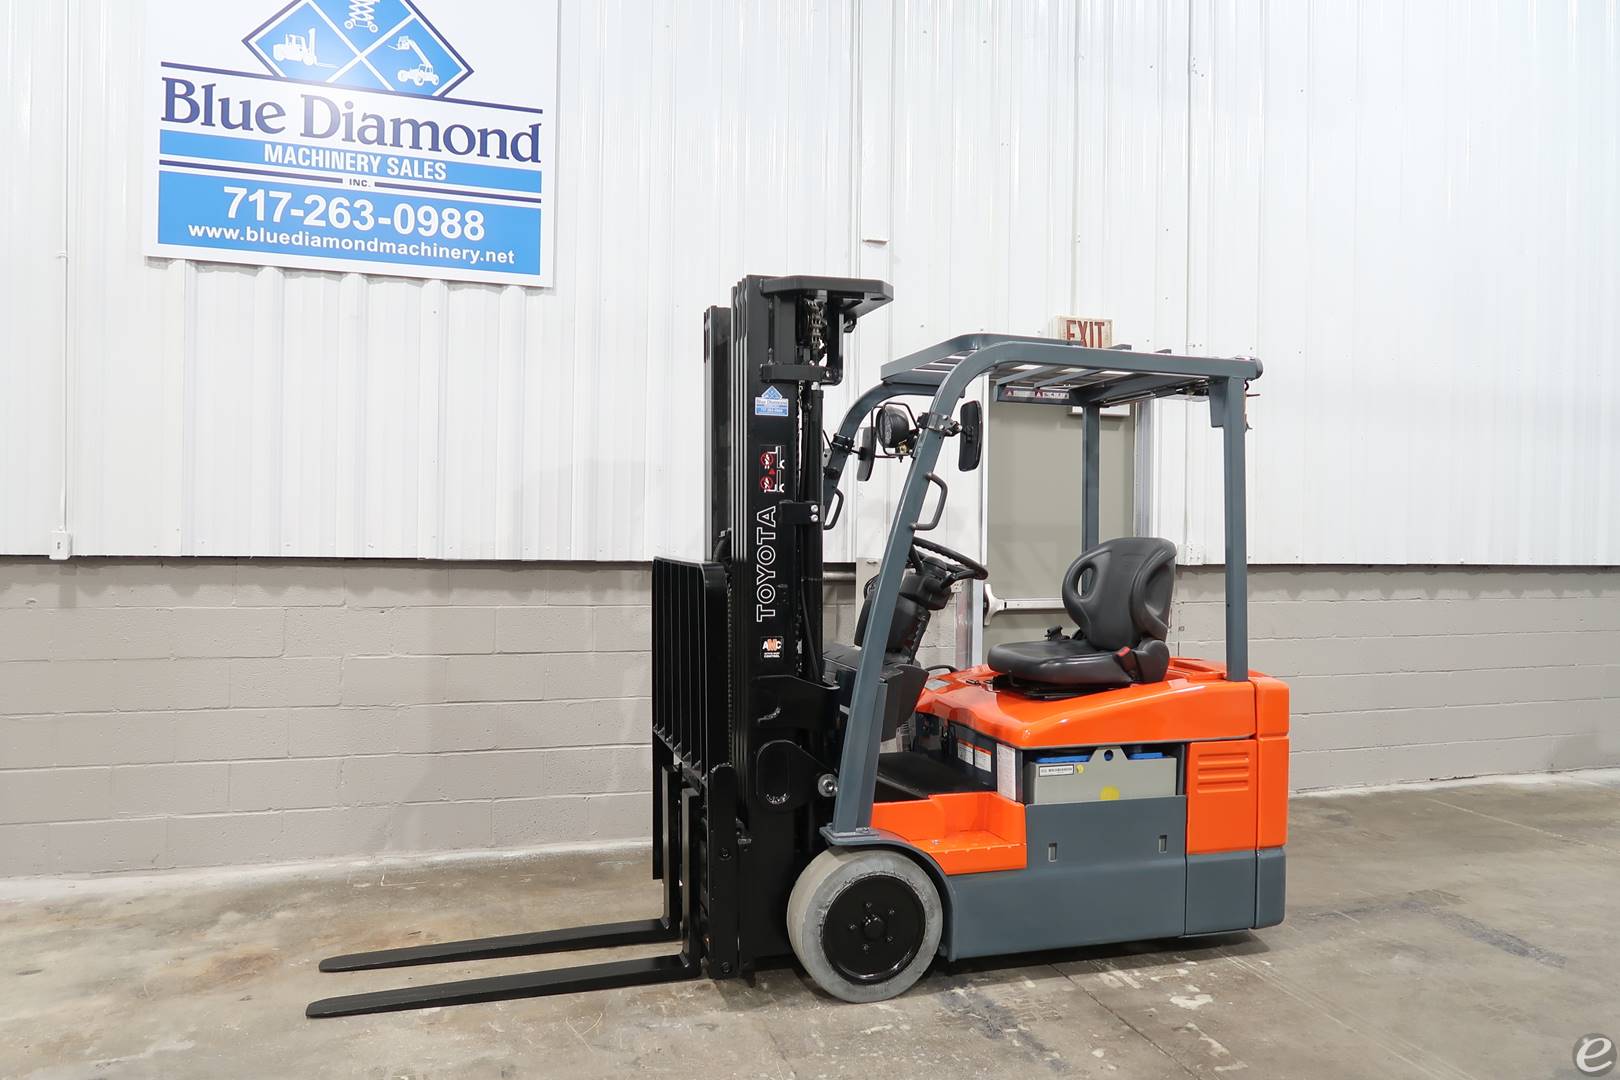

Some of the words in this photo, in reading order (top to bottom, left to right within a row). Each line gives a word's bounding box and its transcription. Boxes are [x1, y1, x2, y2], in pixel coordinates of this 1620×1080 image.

[161, 76, 286, 134] Blue
[300, 94, 542, 163] Diamond
[264, 143, 381, 174] MACHINERY
[387, 157, 447, 181] SALES
[348, 178, 371, 188] INC.
[223, 186, 485, 242] 717-263-0988
[188, 224, 515, 264] www.bluediamondmachinery.net
[1066, 319, 1105, 348] EXIT
[756, 505, 776, 623] TOYOTA
